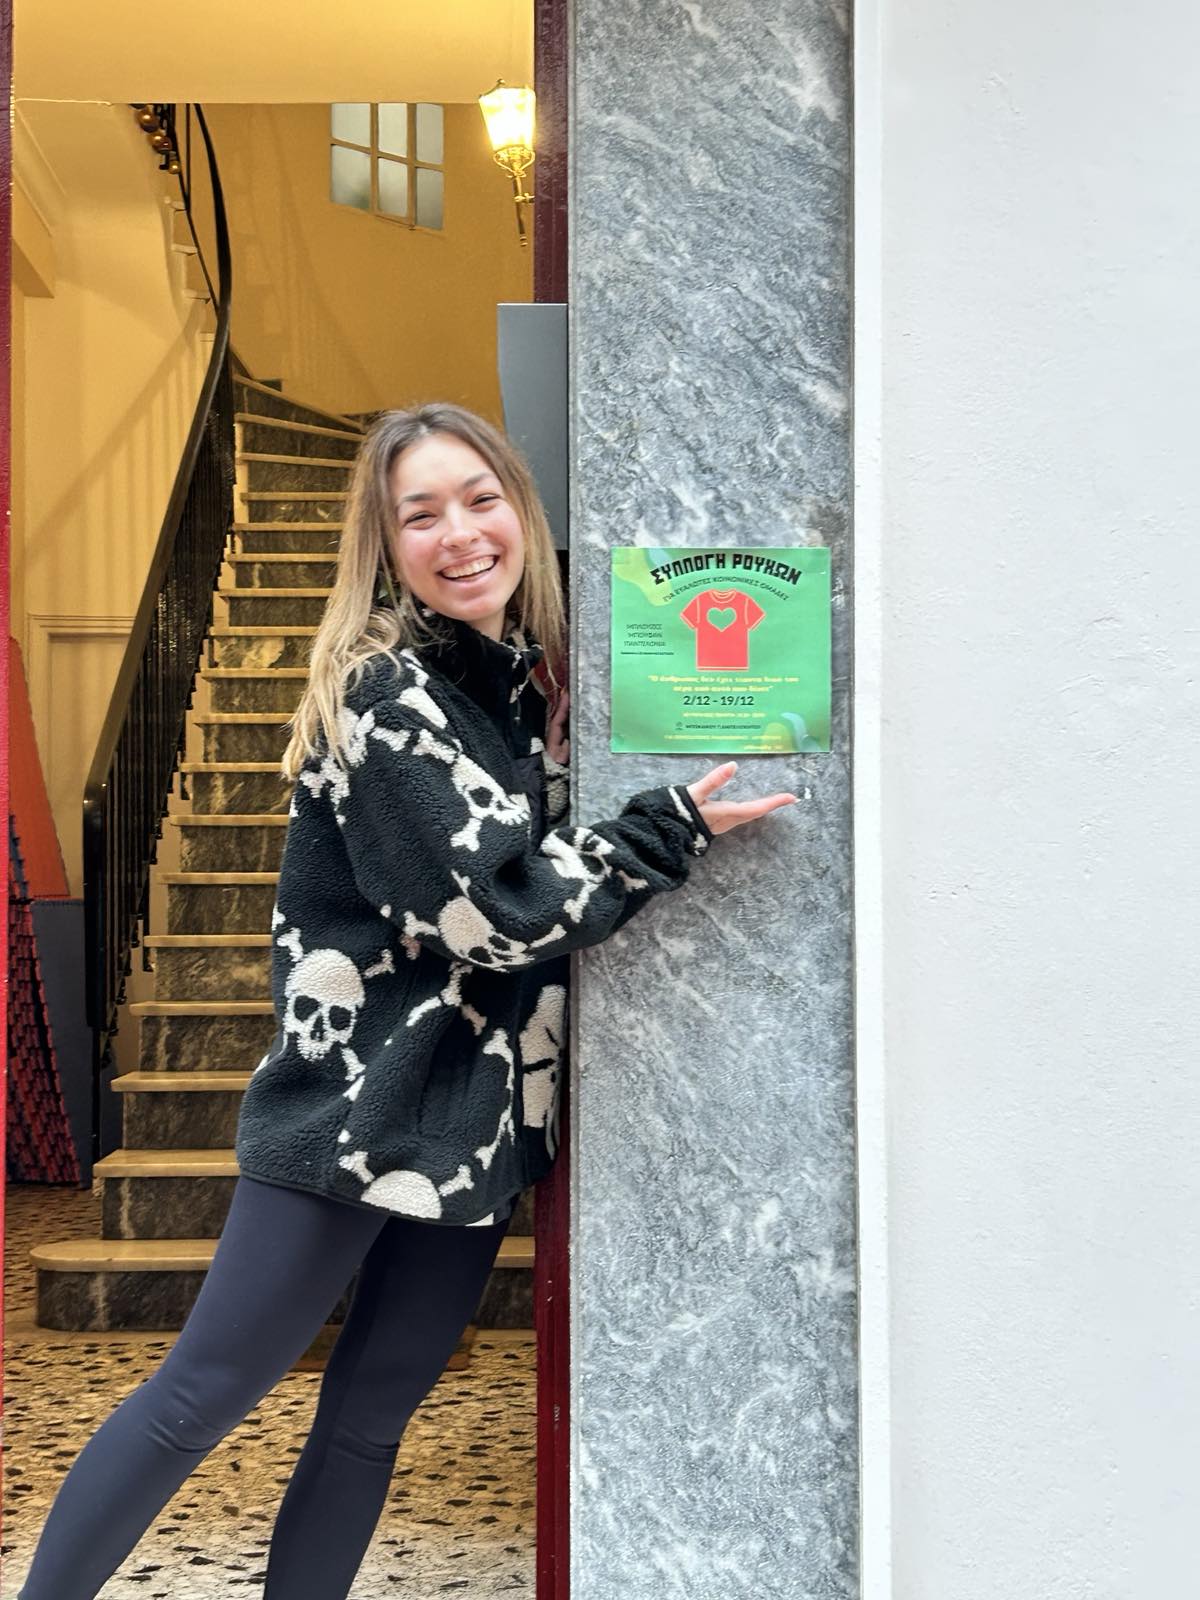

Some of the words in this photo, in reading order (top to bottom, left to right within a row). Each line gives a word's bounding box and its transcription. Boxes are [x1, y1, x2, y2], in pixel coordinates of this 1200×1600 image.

[732, 553, 802, 585] ΡΟΥΧΩΝ
[683, 696, 711, 706] 2/12
[720, 696, 755, 706] 19/12
